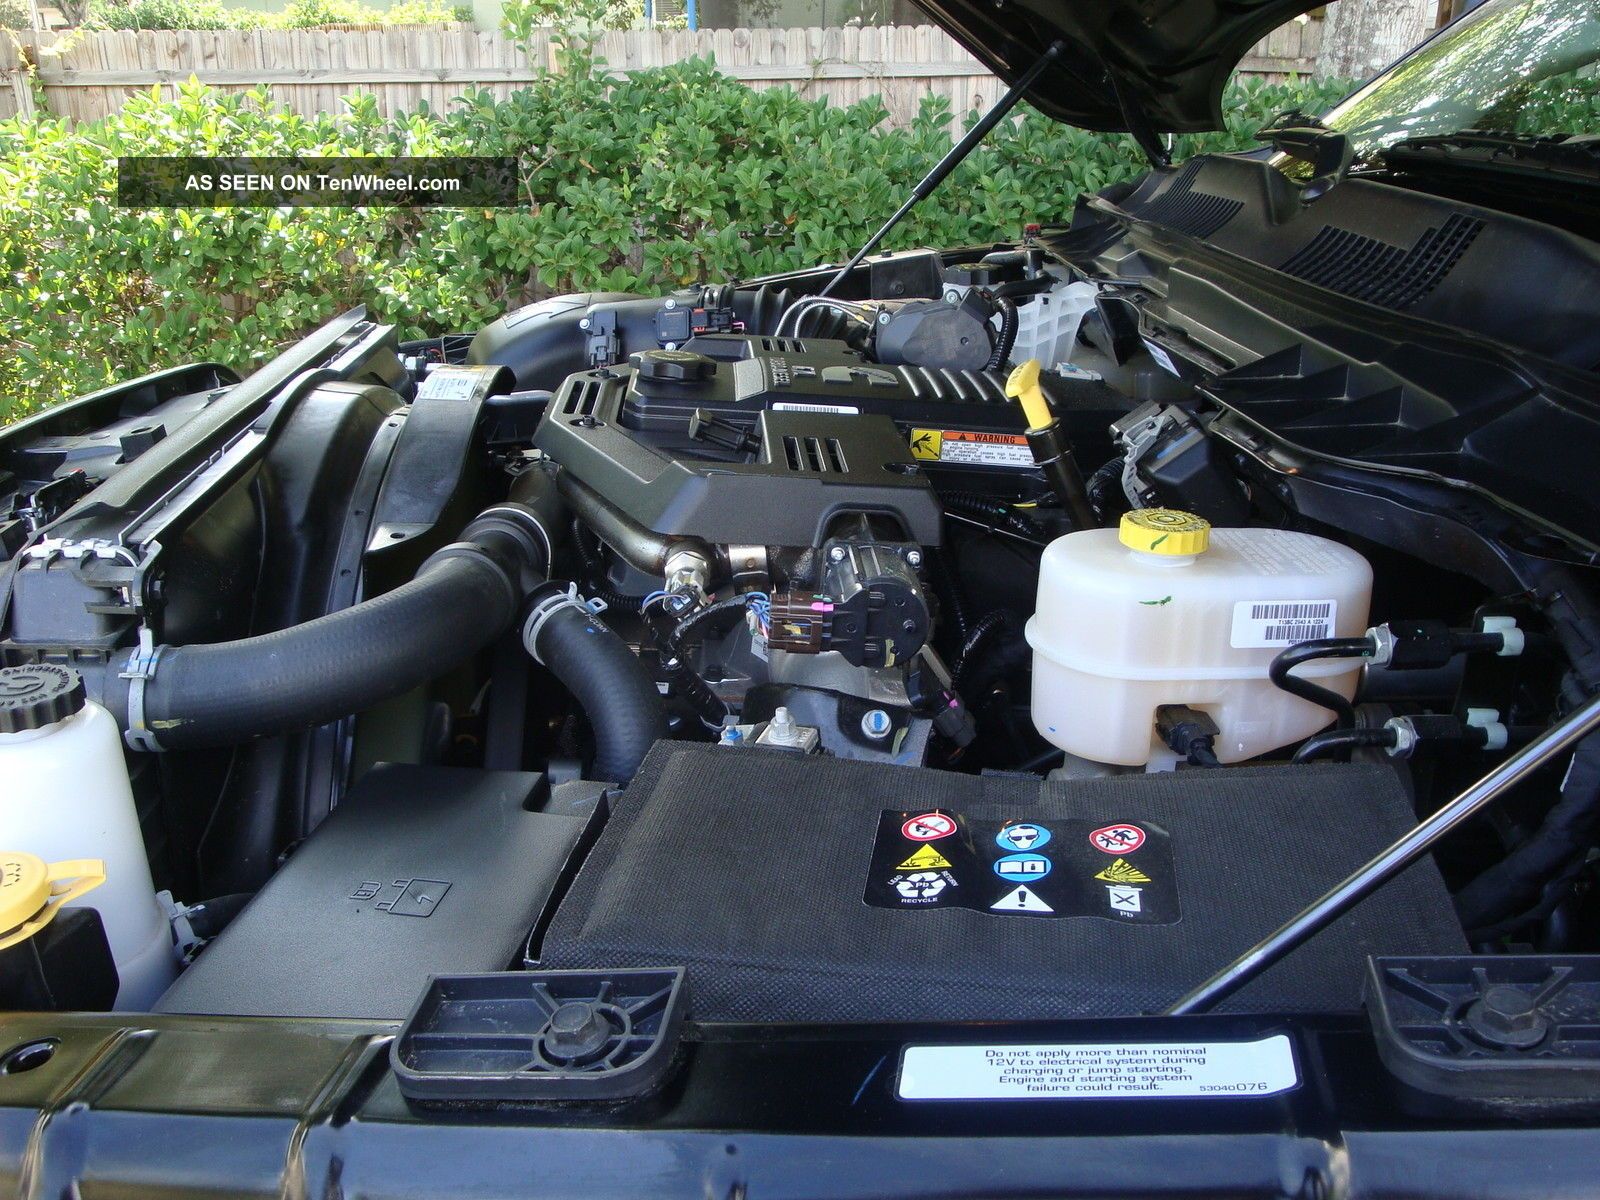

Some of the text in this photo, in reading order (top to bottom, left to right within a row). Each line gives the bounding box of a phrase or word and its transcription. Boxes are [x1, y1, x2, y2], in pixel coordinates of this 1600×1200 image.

[974, 433, 1016, 444] WARNING
[985, 1050, 1004, 1058] Do
[1036, 1049, 1071, 1058] apply
[1076, 1049, 1112, 1057] more
[1116, 1048, 1148, 1056] than
[1152, 1047, 1207, 1056] nominal
[1038, 1058, 1102, 1066] electrical
[1106, 1058, 1157, 1066] system
[1162, 1056, 1206, 1065] during
[1004, 1067, 1063, 1076] charging
[1088, 1066, 1122, 1075] jump
[1126, 1065, 1186, 1074] starting.
[999, 1074, 1193, 1085] Engine and starting system
[1026, 1083, 1164, 1092] failure could result.
